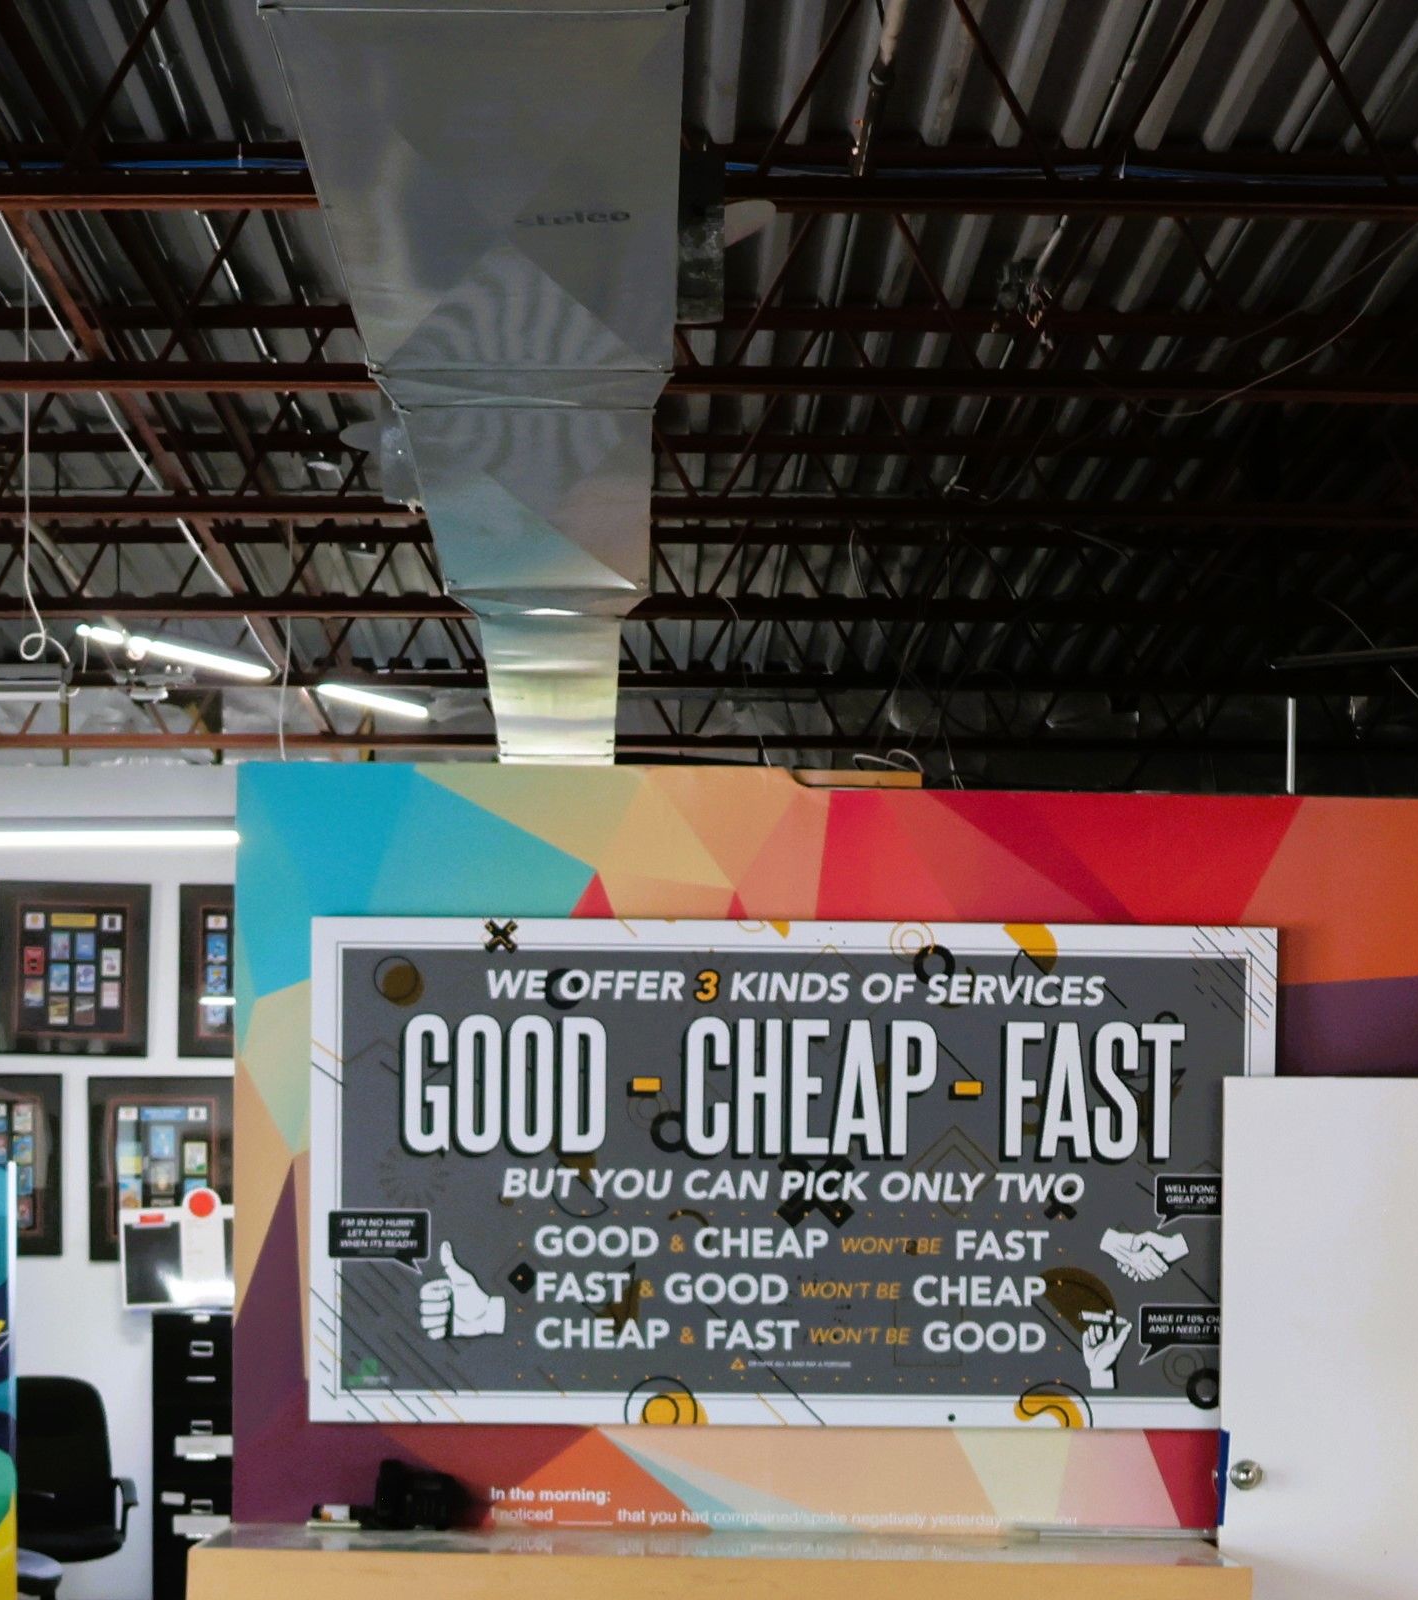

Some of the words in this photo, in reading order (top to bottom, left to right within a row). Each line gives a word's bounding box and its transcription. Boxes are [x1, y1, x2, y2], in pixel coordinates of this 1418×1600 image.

[487, 969, 548, 1000] WE
[559, 970, 685, 1001] OFFER
[695, 970, 720, 1002] 3
[730, 972, 850, 1003] KINDS
[861, 973, 917, 1004] OF
[926, 974, 1106, 1006] SERVICES
[403, 1014, 607, 1153] GOOD
[686, 1016, 938, 1155] CHEAP
[1005, 1021, 1186, 1160] FAST
[502, 1168, 579, 1199] BUT
[590, 1169, 673, 1200] YOU
[684, 1169, 769, 1200] CAN
[780, 1170, 870, 1201] PICK
[880, 1171, 985, 1203] ONLY
[995, 1172, 1085, 1203] TWO
[1166, 1195, 1194, 1204] GREAT
[534, 1225, 659, 1257] GOOD
[670, 1234, 685, 1253] &
[694, 1226, 829, 1258] CHEAP
[841, 1236, 913, 1255] WON'T
[917, 1237, 943, 1255] BE
[955, 1229, 1049, 1261] FAST
[536, 1272, 630, 1303] FAST
[639, 1279, 655, 1298] &
[664, 1273, 789, 1305] GOOD
[800, 1282, 871, 1300] WON'T
[876, 1282, 902, 1300] BE
[913, 1275, 1047, 1307] CHEAP
[535, 1317, 670, 1349] CHEAP
[680, 1327, 695, 1345] &
[706, 1319, 800, 1350] FAST
[809, 1327, 879, 1345] WON'T
[885, 1327, 911, 1345] BE
[922, 1320, 1047, 1353] GOOD
[1148, 1314, 1173, 1323] MAKE
[1176, 1314, 1184, 1323] IT
[1149, 1325, 1169, 1334] AND
[1176, 1325, 1200, 1334] NEED
[491, 1487, 505, 1500] In
[509, 1487, 535, 1500] the
[539, 1488, 611, 1505] morning:
[500, 1507, 553, 1521] noticed
[617, 1508, 645, 1521] that
[650, 1510, 677, 1525] you
[682, 1508, 709, 1522] had
[852, 1510, 925, 1528] negatively
[931, 1511, 1002, 1529] yesterday
